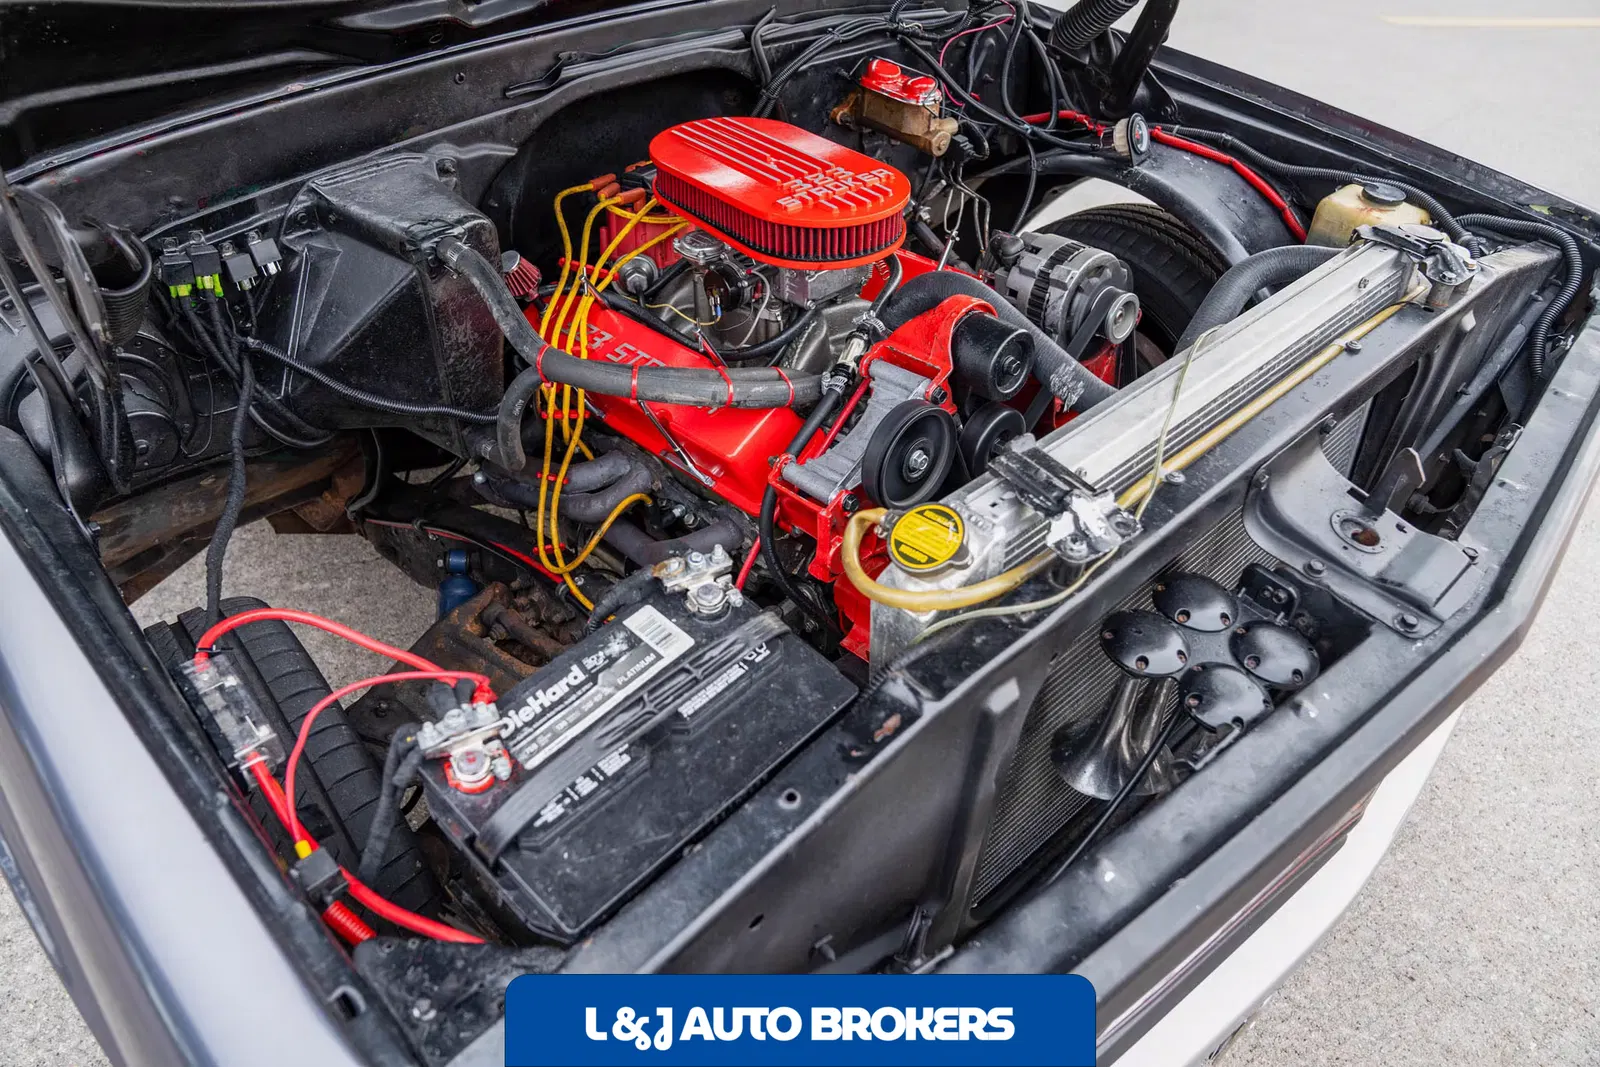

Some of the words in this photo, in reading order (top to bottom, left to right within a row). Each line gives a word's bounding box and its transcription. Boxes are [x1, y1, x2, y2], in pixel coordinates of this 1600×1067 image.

[776, 168, 895, 212] STROKER
[616, 652, 657, 685] PLATINUM
[499, 664, 587, 739] DieHard
